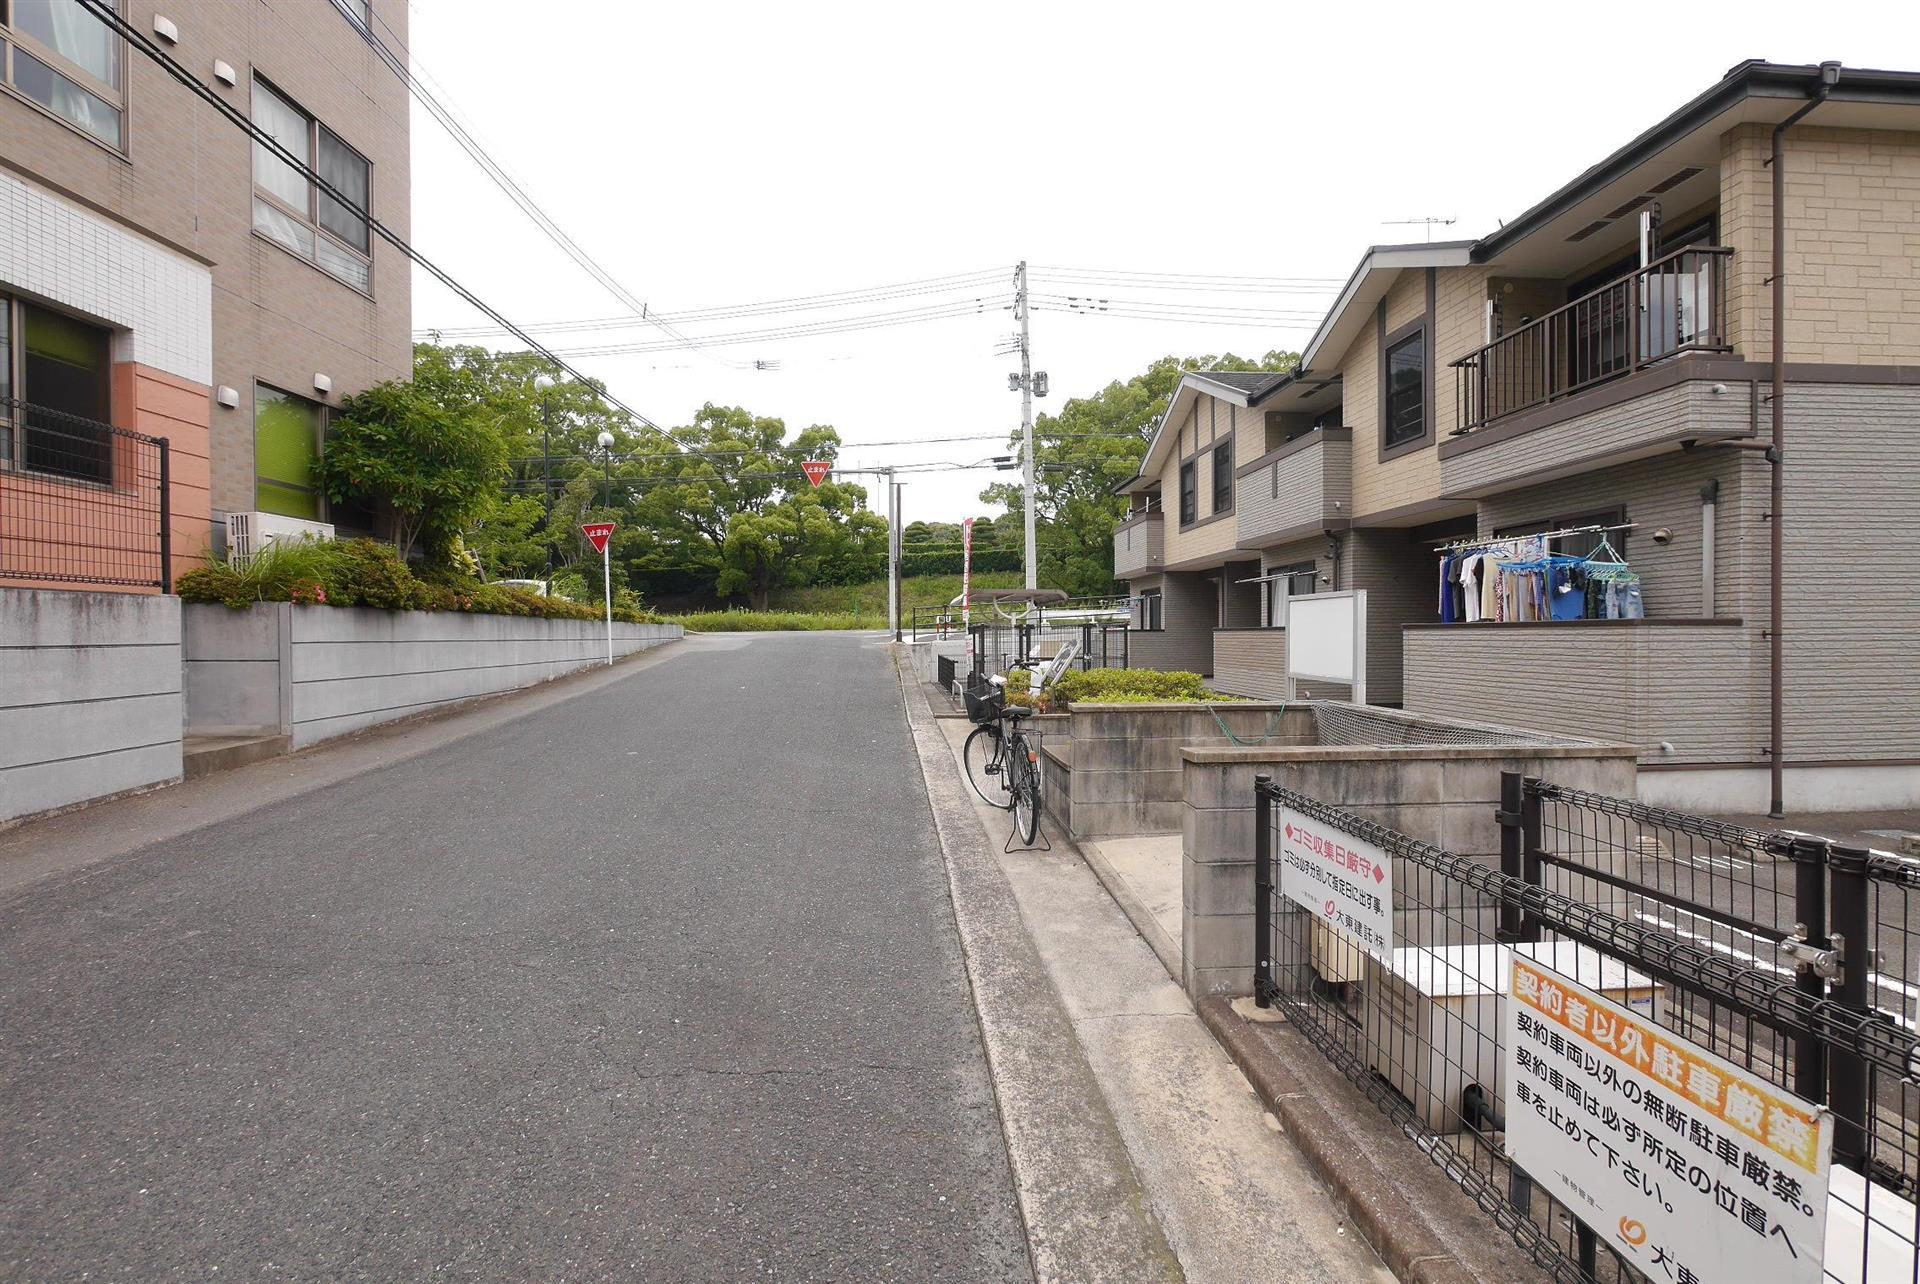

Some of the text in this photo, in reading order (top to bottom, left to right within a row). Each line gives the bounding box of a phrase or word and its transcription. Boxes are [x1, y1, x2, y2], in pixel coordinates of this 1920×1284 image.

[590, 529, 610, 537] 止まれ
[1294, 827, 1371, 879] ゴミ収集日厳守
[1516, 967, 1812, 1161] 契約者以外駐車厳禁
[1517, 1011, 1815, 1217] 契約車両以外の無断駐車厳禁。
[1517, 1081, 1674, 1214] 車を止めて下さい。
[1517, 1046, 1798, 1259] 契約車両は必ず所定の位置へ
